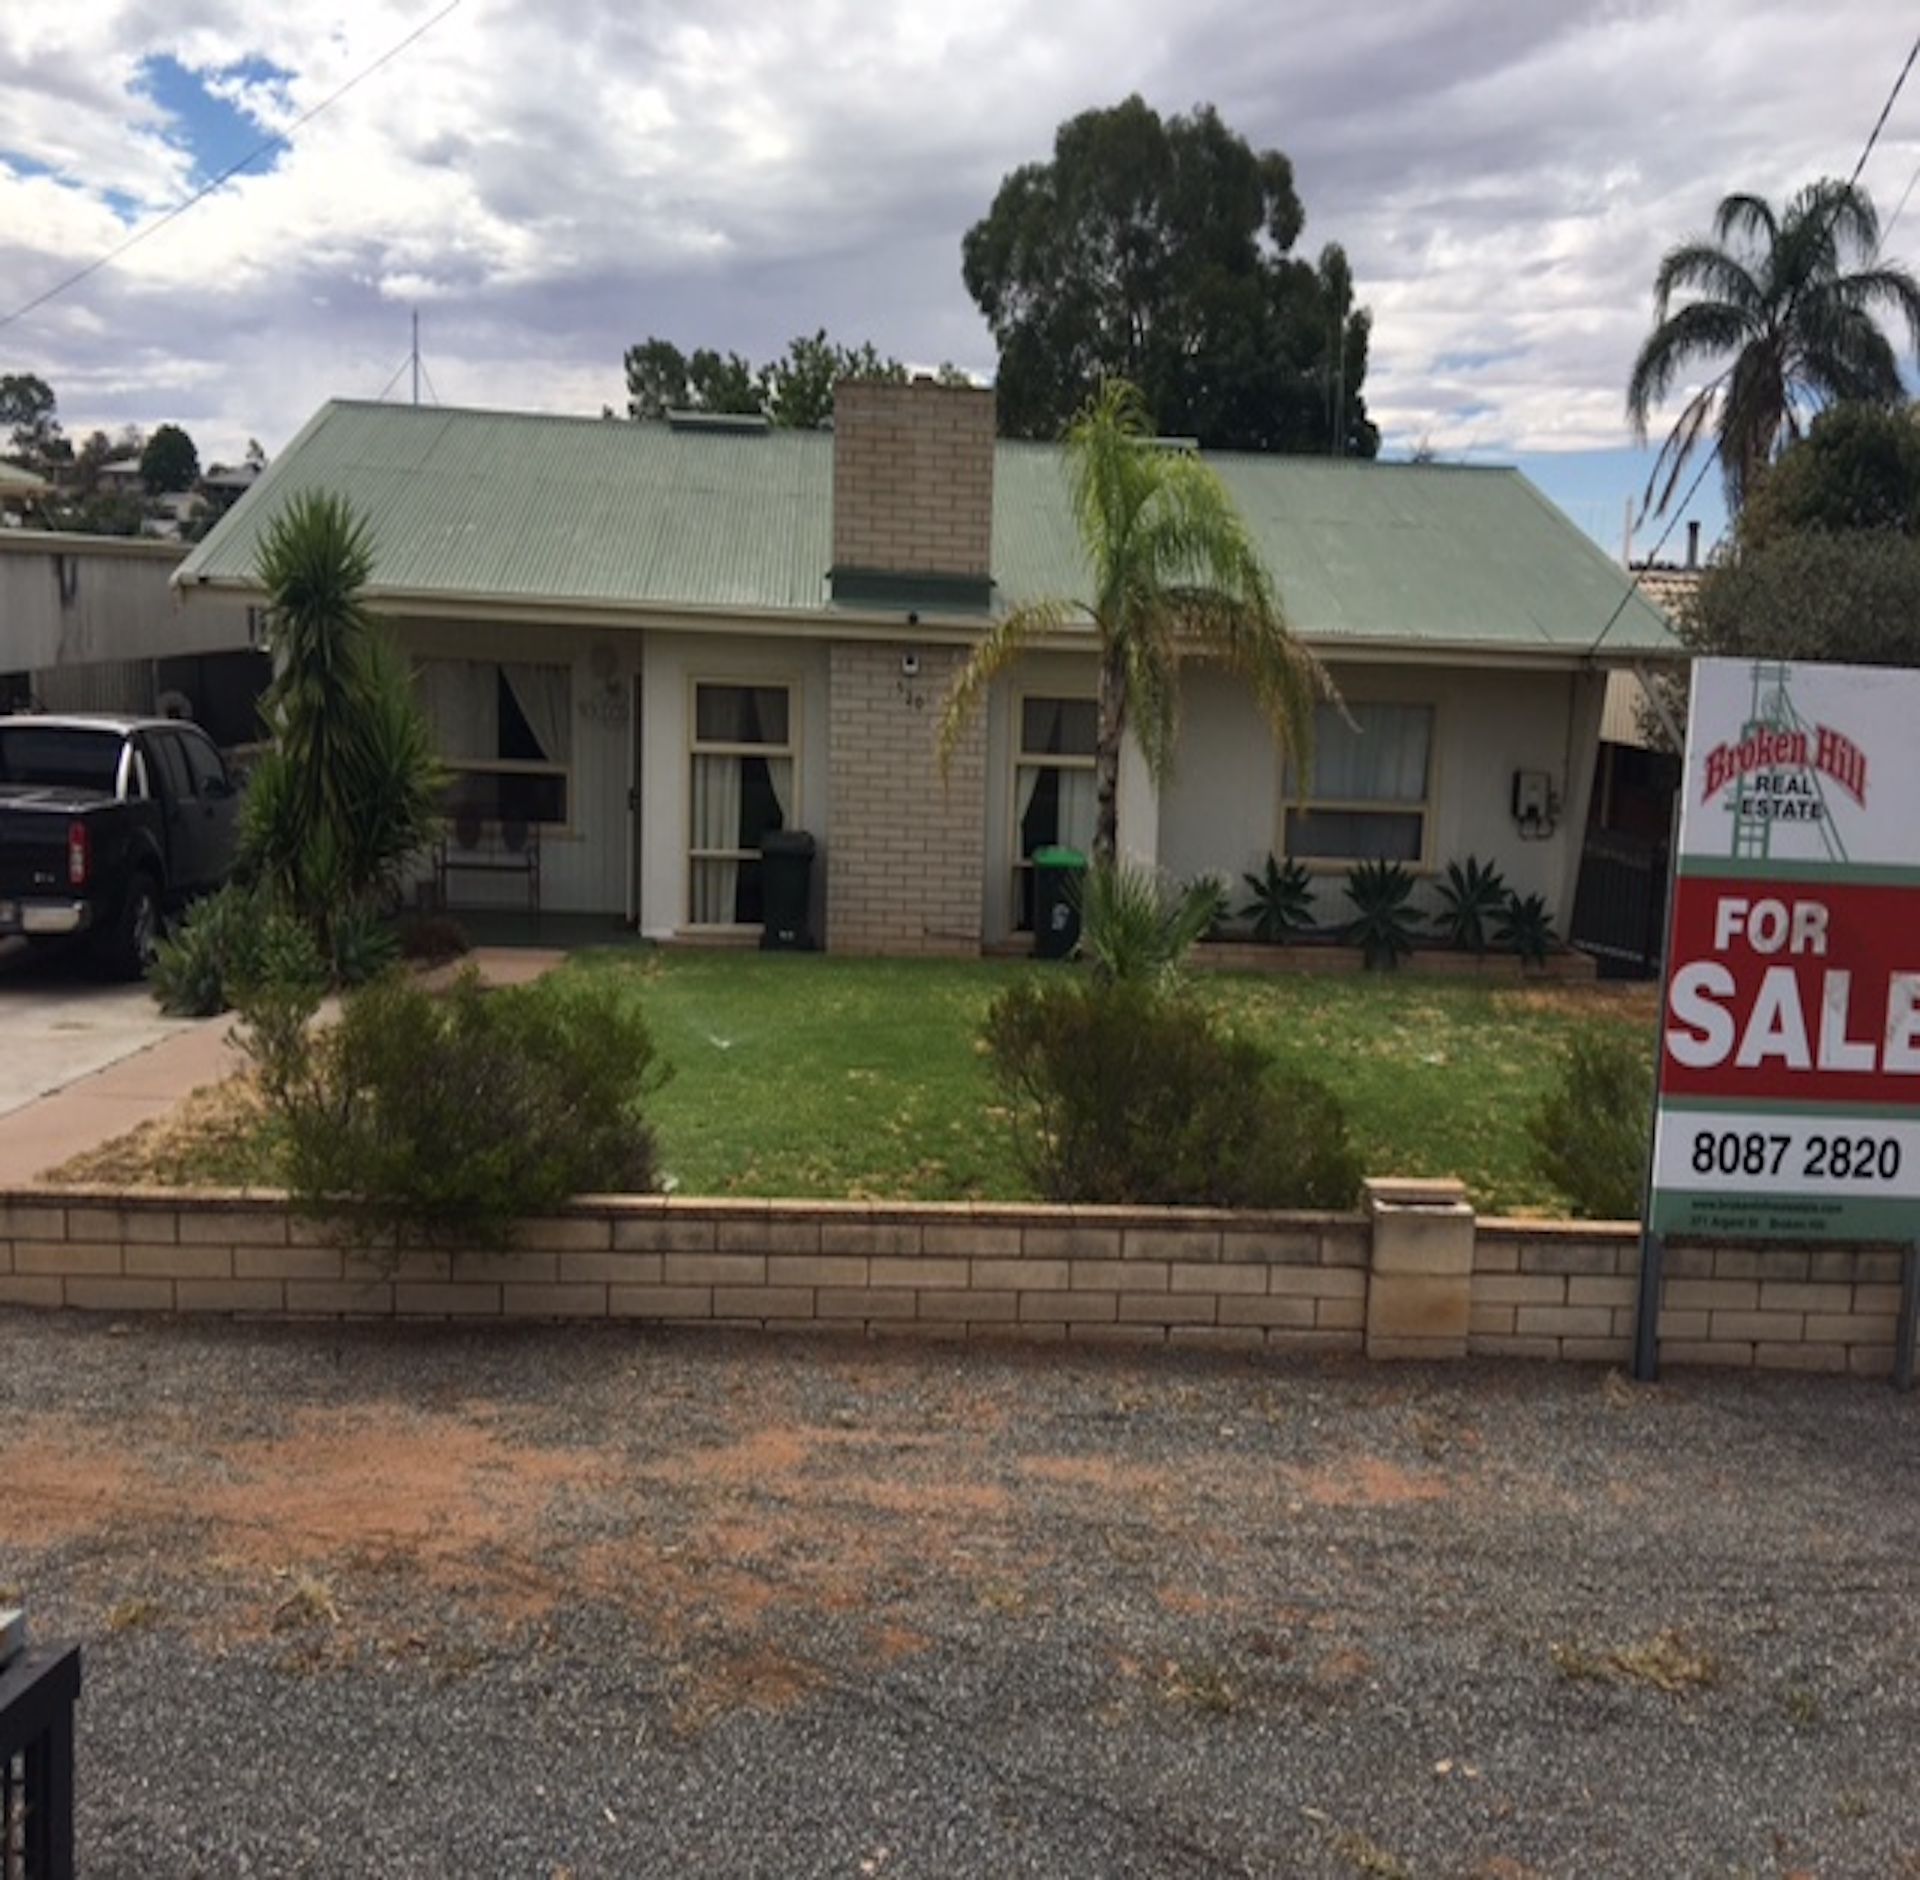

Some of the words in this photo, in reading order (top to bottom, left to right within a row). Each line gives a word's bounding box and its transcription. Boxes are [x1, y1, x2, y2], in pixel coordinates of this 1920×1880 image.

[1702, 724, 1808, 804] Broken
[1816, 723, 1867, 810] Hill
[1755, 774, 1813, 797] REAL
[1741, 799, 1824, 820] ESTATE
[1714, 897, 1829, 955] FOR
[1665, 961, 1920, 1074] SALE
[1692, 1131, 1791, 1175] 8087
[1803, 1136, 1901, 1179] 2820
